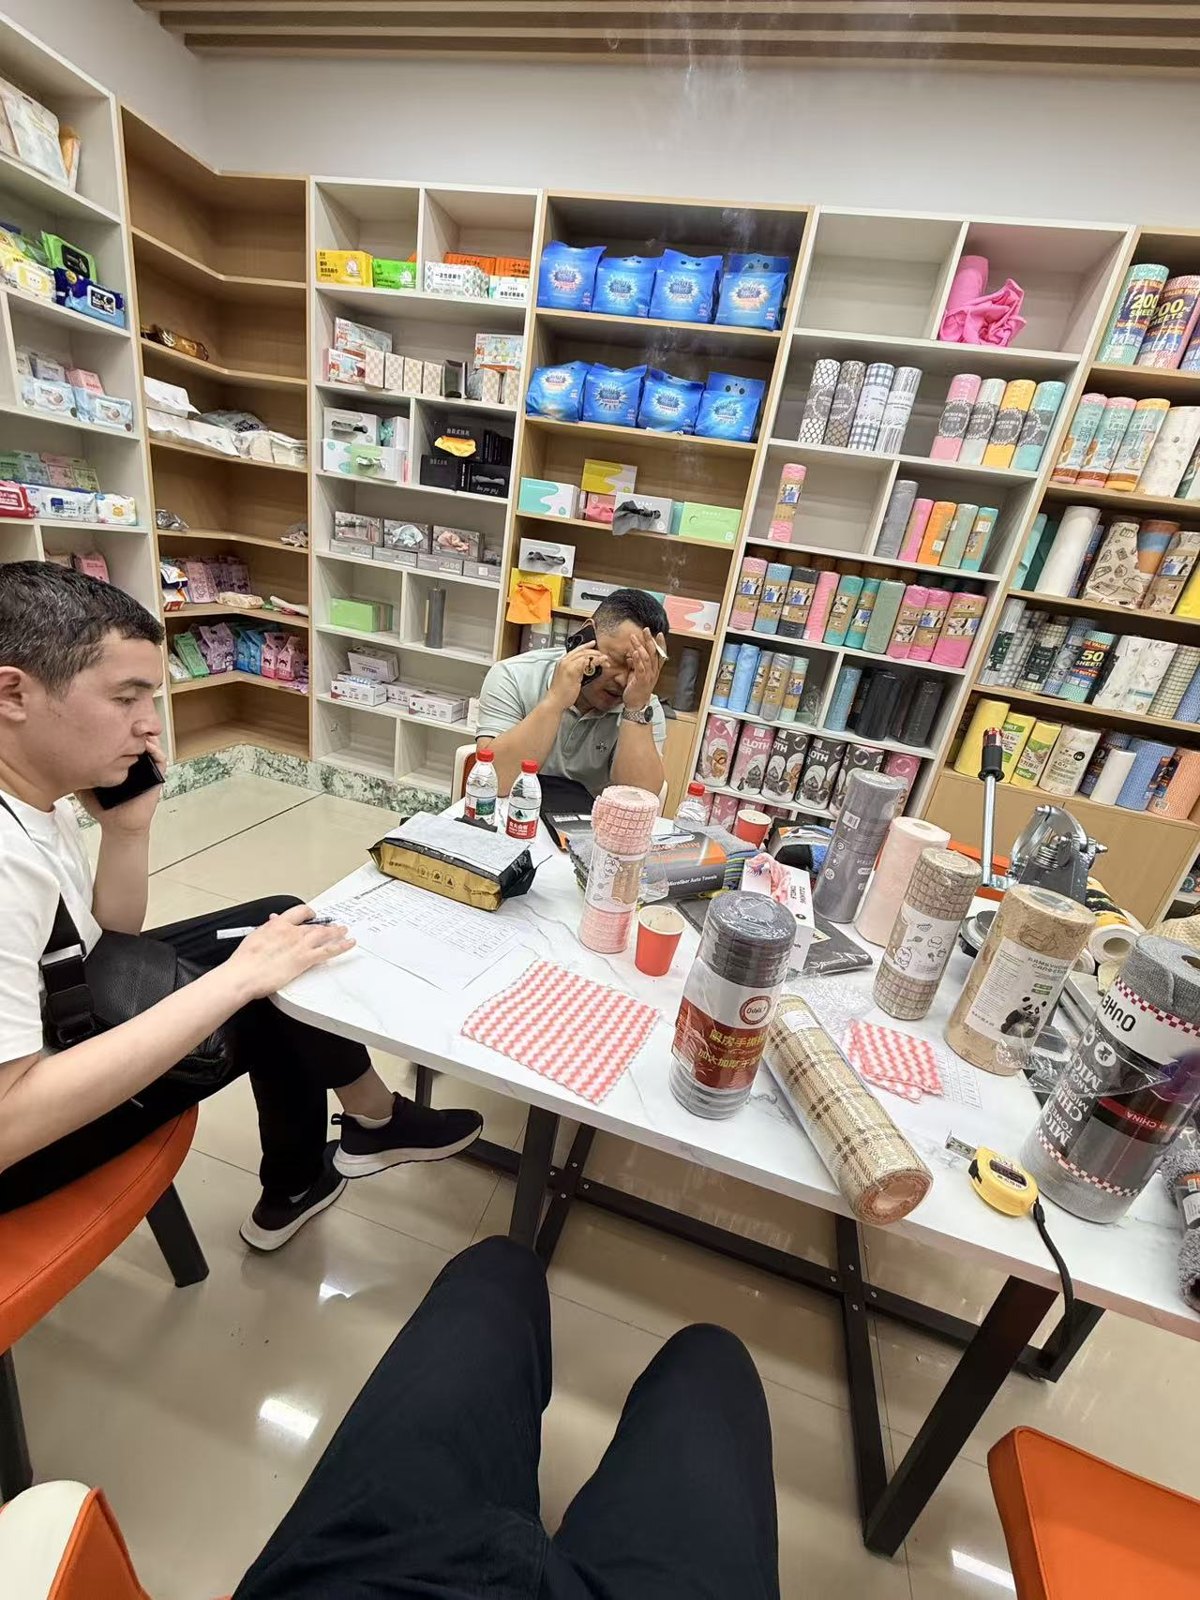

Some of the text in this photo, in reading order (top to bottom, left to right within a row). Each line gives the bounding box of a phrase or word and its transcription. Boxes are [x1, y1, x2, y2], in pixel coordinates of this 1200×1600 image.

[1081, 650, 1105, 662] 50
[742, 737, 771, 750] CLOTH
[702, 874, 718, 882] Towels
[1126, 1111, 1157, 1129] CHINA
